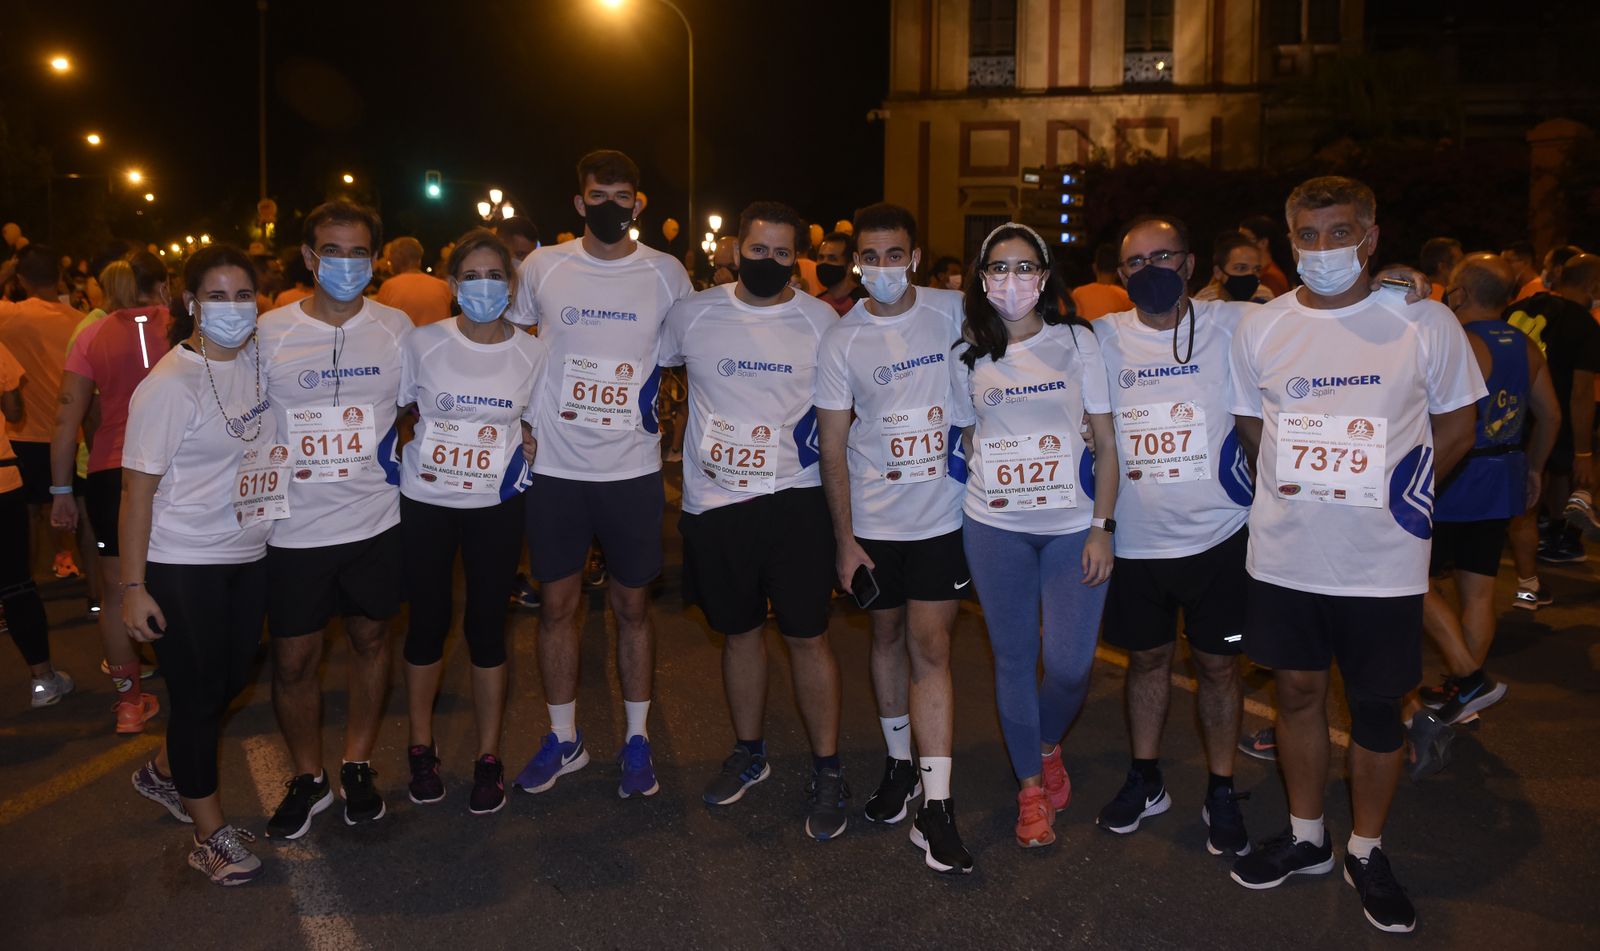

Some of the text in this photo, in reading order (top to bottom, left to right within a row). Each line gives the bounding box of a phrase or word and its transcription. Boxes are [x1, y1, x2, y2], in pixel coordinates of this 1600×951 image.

[581, 309, 637, 321] KLINGER
[581, 318, 601, 326] Spain
[738, 361, 793, 373] KLINGER
[892, 353, 944, 372] KLINGER
[321, 367, 380, 378] KLINGER
[893, 370, 914, 380] Spain
[1138, 364, 1200, 378] KLINGER
[1138, 379, 1160, 387] Spain
[1312, 375, 1381, 387] KLINGER
[573, 381, 628, 406] 6165
[1005, 381, 1066, 395] KLINGER
[1312, 388, 1335, 397] Spain
[457, 395, 513, 408] KLINGER
[1005, 396, 1028, 404] Spain
[456, 405, 476, 413] Spain
[301, 432, 362, 456] 6114
[890, 431, 944, 458] 6713
[1130, 430, 1192, 456] 7087
[331, 457, 350, 465] POZAS
[432, 444, 490, 470] 6116
[710, 443, 766, 468] 6125
[916, 455, 936, 464] LOZANO
[1292, 446, 1368, 474] 7379
[997, 461, 1059, 485] 6127
[240, 471, 278, 497] 6119
